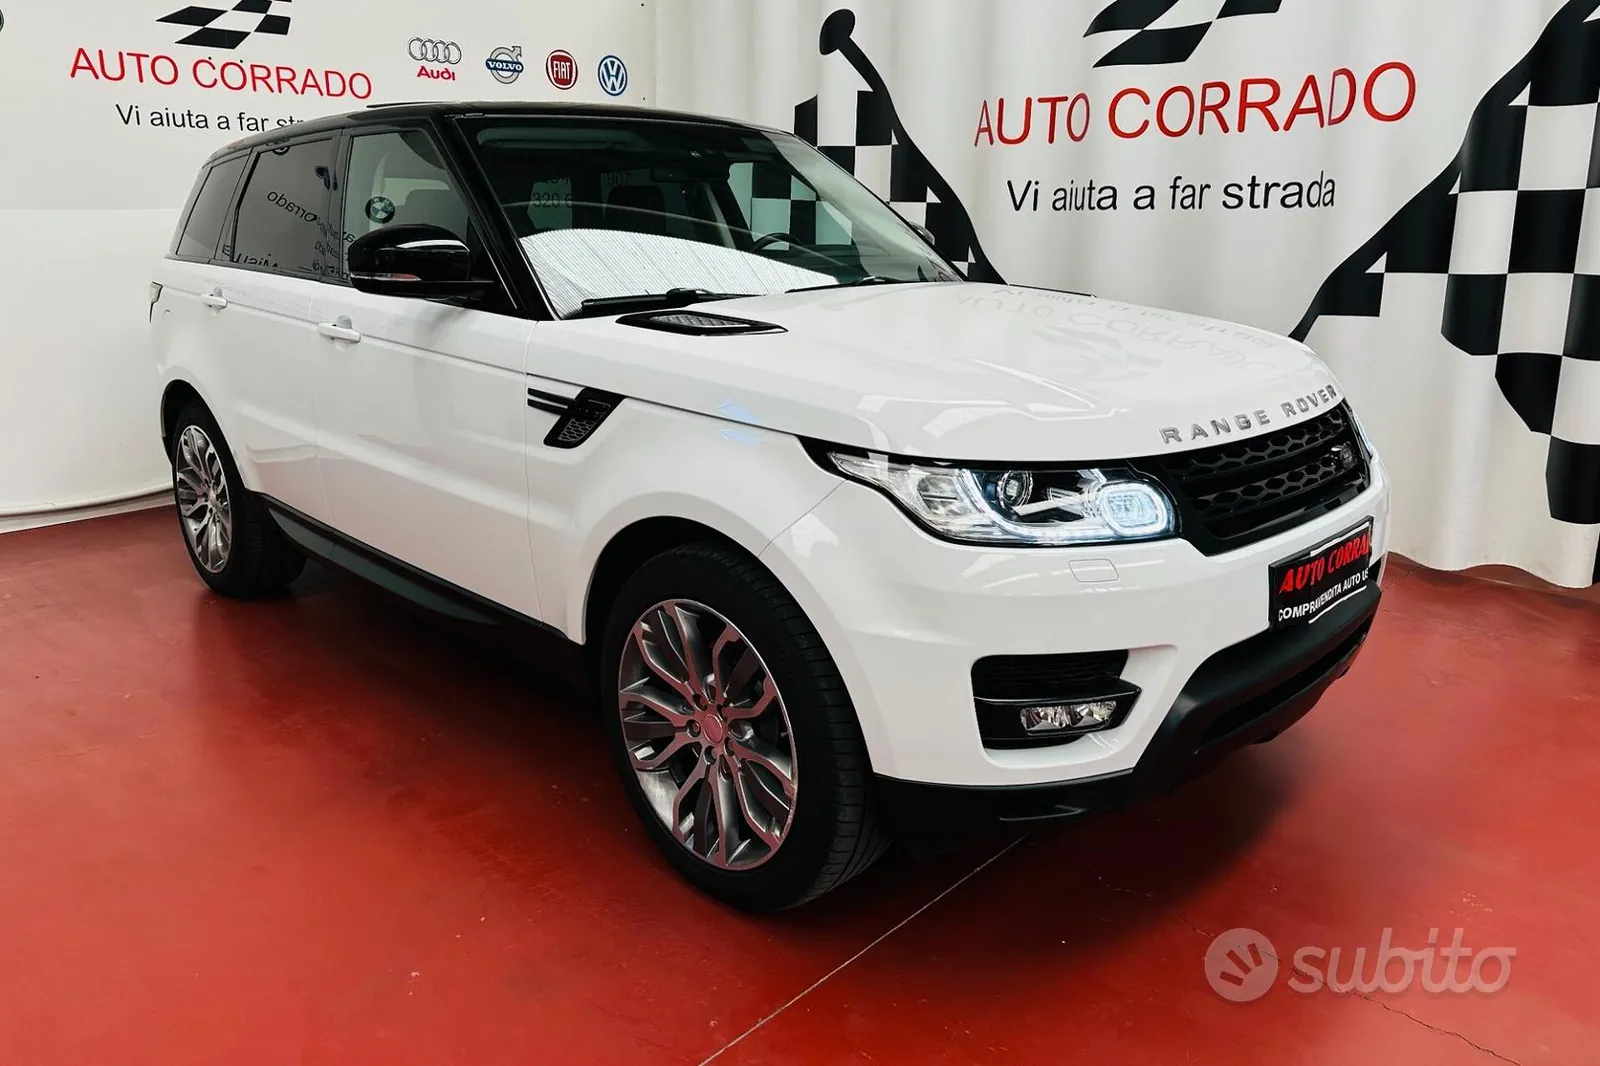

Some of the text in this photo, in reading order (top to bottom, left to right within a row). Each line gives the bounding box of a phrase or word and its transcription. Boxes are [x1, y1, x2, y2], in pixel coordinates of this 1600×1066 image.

[70, 48, 372, 100] AUTO CORRADO
[416, 65, 456, 81] Audi
[488, 61, 523, 72] VOLVO
[552, 60, 571, 81] FIAT
[115, 104, 141, 126] Vi
[150, 107, 210, 130] aiuta
[217, 116, 231, 131] a
[236, 111, 270, 132] far
[975, 60, 1417, 146] AUTO CORRADO
[1006, 169, 1336, 212] Vi aiuta a far strada
[1159, 384, 1338, 444] RANGE ROVER
[1279, 533, 1369, 593] AUTO CORRA
[1278, 582, 1342, 622] COMPRAVENDITA
[1342, 572, 1361, 592] AUTO
